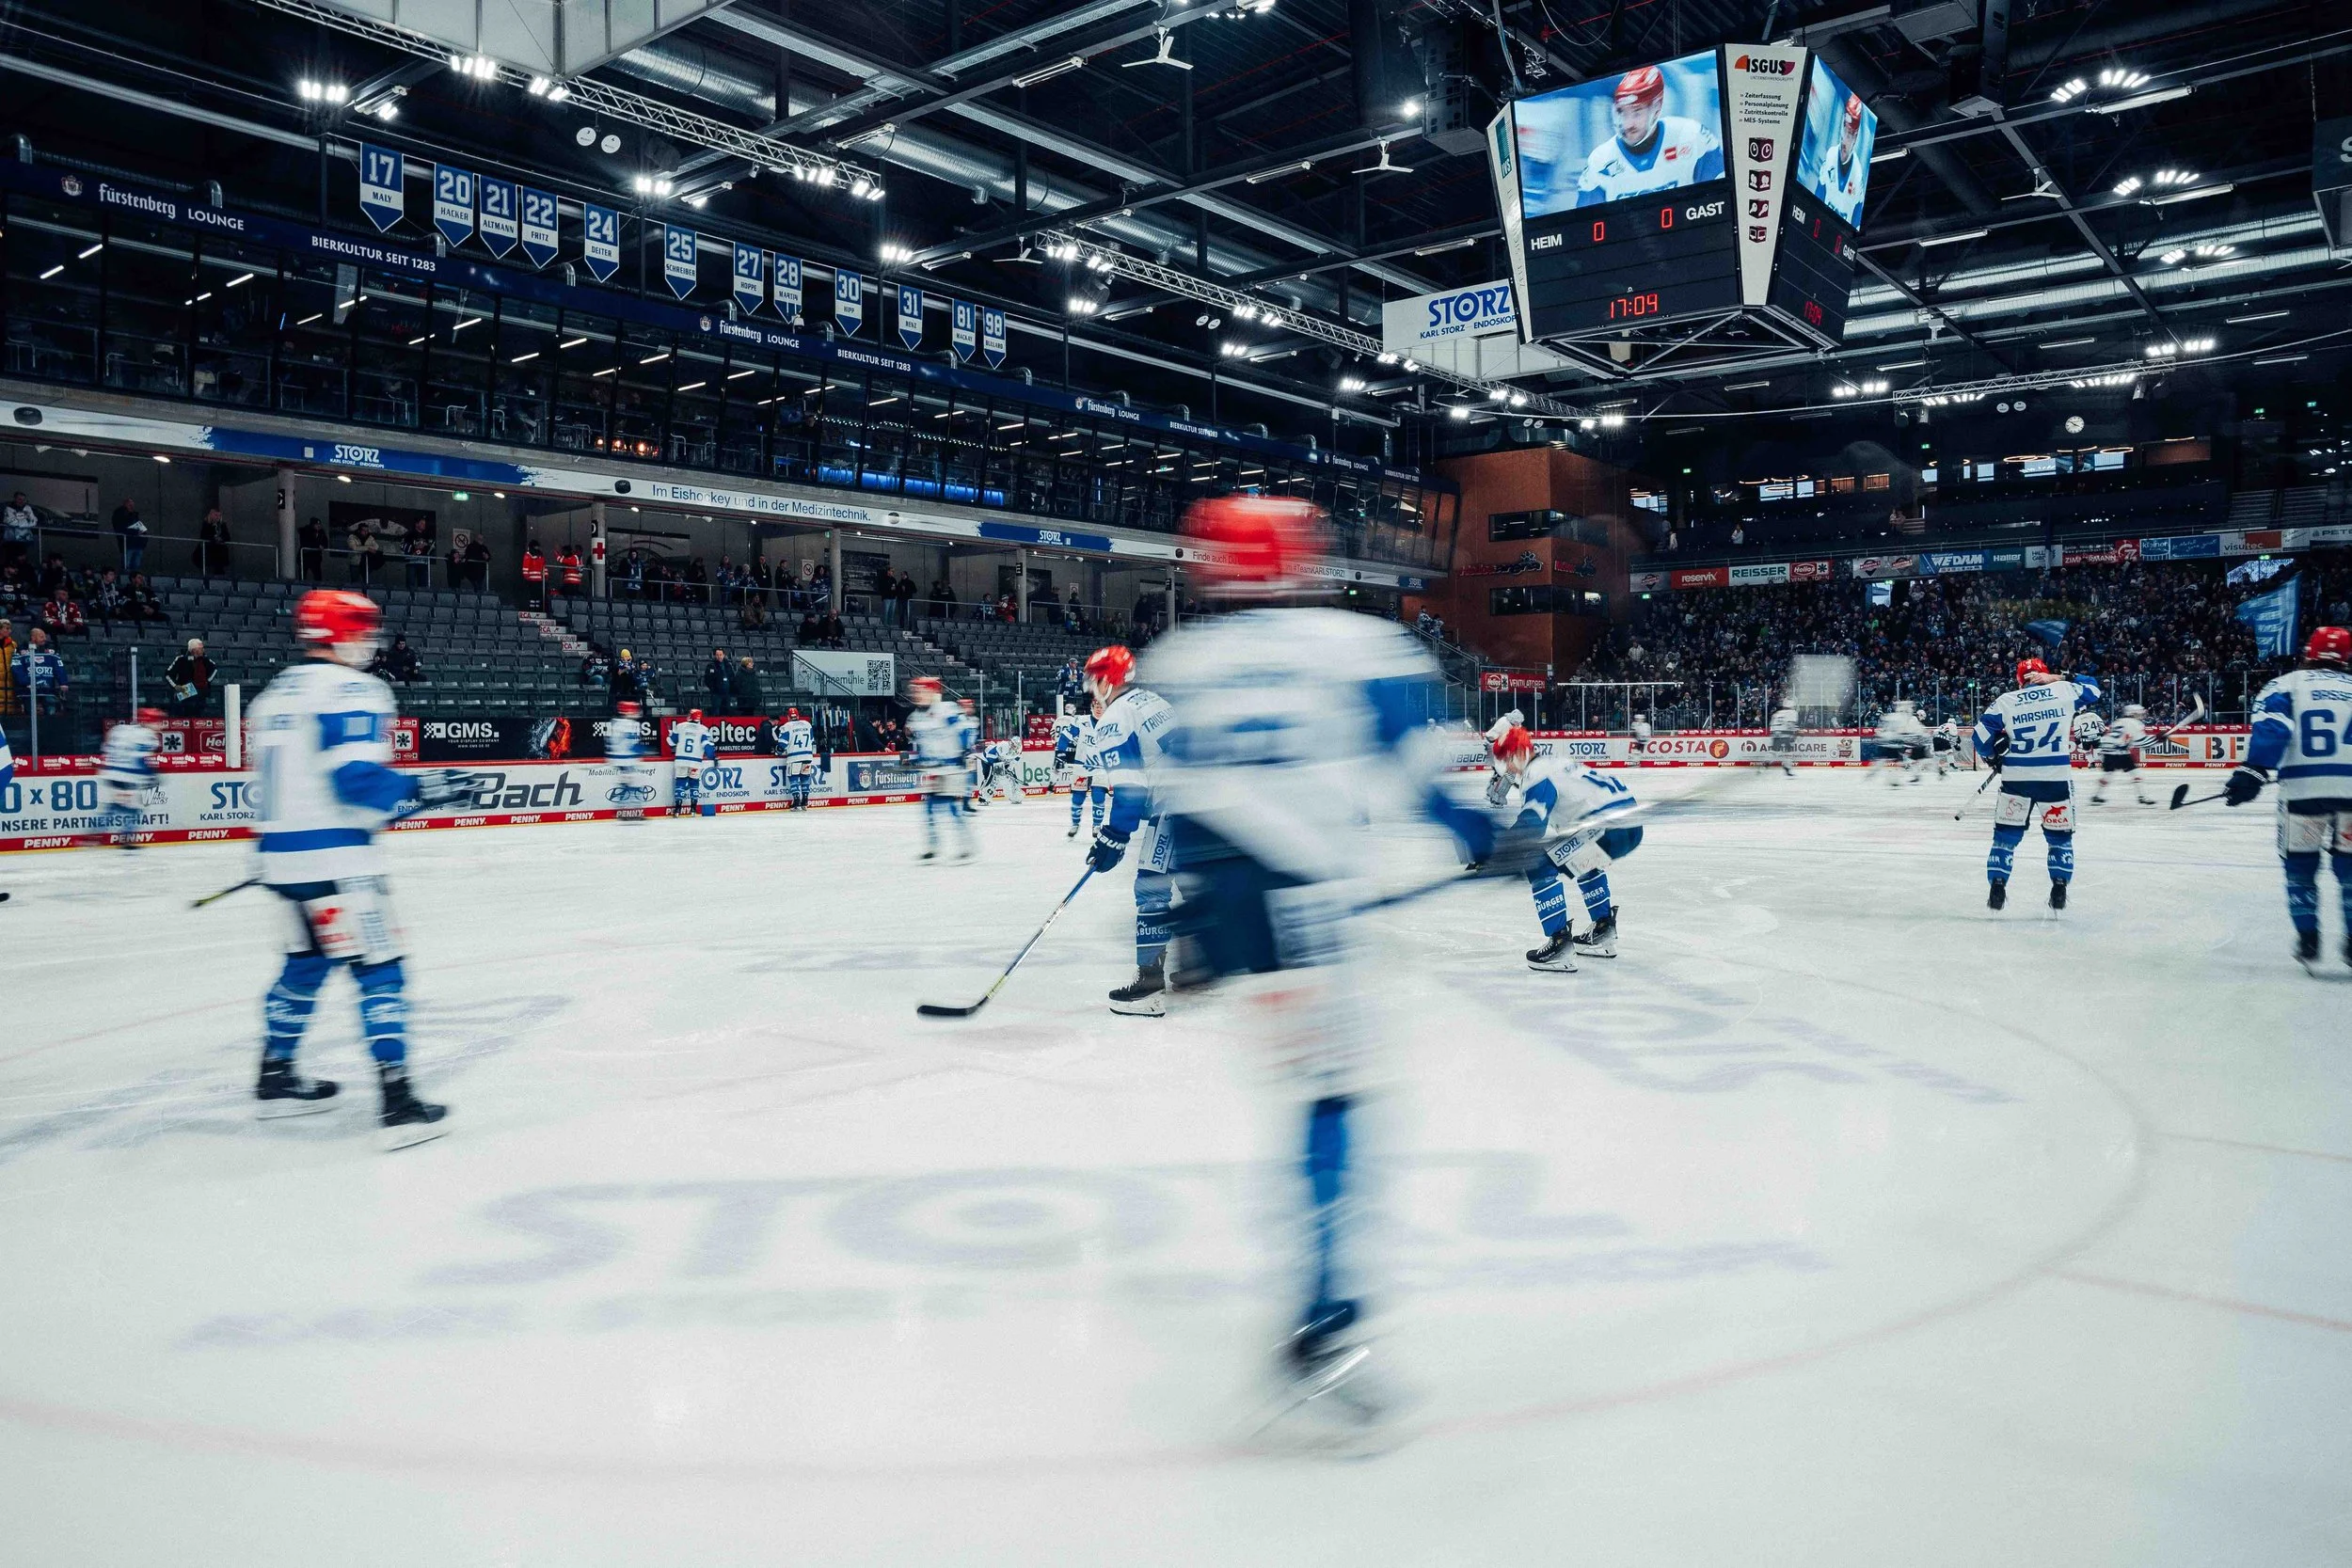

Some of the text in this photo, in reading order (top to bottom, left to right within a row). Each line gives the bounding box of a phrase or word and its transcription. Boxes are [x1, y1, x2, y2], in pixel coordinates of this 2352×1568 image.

[1746, 58, 1787, 75] ISGUS
[1744, 92, 1782, 101] Zeiterfassung
[1743, 101, 1789, 109] Personalplanung
[1743, 117, 1780, 125] MES-Systeme
[368, 151, 395, 186] 17
[439, 170, 470, 205] 20
[372, 191, 393, 204] MALY
[486, 183, 510, 216] 21
[440, 206, 469, 221] HACKER
[526, 194, 554, 228] 22
[1661, 208, 1673, 229] 0
[1685, 201, 1725, 220] GAST
[1791, 204, 1806, 225] HEIM
[188, 207, 245, 231] LOUNGE
[483, 219, 515, 234] ALTMANN
[588, 211, 614, 243] 24
[531, 230, 549, 242] FRITZ
[1593, 221, 1604, 242] 0
[668, 231, 692, 261] 25
[1531, 233, 1563, 251] HEIM
[311, 235, 437, 273] BIERKULTUR SEIT 1283
[591, 245, 612, 257] DEITER
[1842, 244, 1856, 261] GAST
[665, 263, 696, 277] SCHREIBER
[738, 248, 759, 277] 27
[777, 259, 799, 287] 28
[740, 281, 757, 292] HOPPE
[837, 274, 859, 302] 30
[779, 291, 799, 302] MARTIN
[902, 291, 918, 317] 31
[1428, 285, 1510, 327] STORZ
[957, 305, 972, 329] 81
[985, 311, 1003, 337] 98
[1420, 324, 1466, 340] KARL STORZ
[767, 333, 800, 349] LOUNGE
[837, 349, 912, 372] BIERKULTUR SEIT 1283
[1118, 410, 1140, 421] LOUNGE
[1169, 420, 1197, 434] BIERKULTUR
[335, 444, 380, 463] STORZ
[652, 484, 871, 521] Im Eishockey und in der Medizintechnik.
[1039, 530, 1061, 542] STORZ
[2223, 542, 2264, 551] visutec
[1192, 551, 1211, 562] Finde
[1731, 566, 1787, 578] REISSER
[1793, 565, 1816, 574] Helios
[1681, 572, 1717, 584] reservix
[1509, 678, 1545, 689] VENTILATOREN
[2016, 688, 2054, 703] STORZ
[2011, 707, 2066, 724] MARSHALL
[2083, 721, 2098, 733] 24
[2300, 708, 2352, 758] 6
[684, 738, 693, 752] 6
[793, 734, 810, 748] 47
[2010, 721, 2062, 754] 54
[1569, 742, 1606, 755] STORZ
[1104, 750, 1120, 768] 53
[771, 765, 827, 787] STRZ
[30, 788, 44, 804] x
[51, 780, 98, 812] 80
[847, 797, 869, 805] PENNY.
[200, 811, 255, 820] KARL STORZ
[453, 816, 487, 827] PENNY.
[511, 815, 542, 824] PENNY.
[564, 812, 596, 821] PENNY.
[394, 819, 430, 831] PENNY.
[24, 837, 72, 848] PENNY.
[188, 829, 230, 840] PENNY.
[1152, 833, 1168, 865] STORZ
[1554, 837, 1581, 859] STORZ
